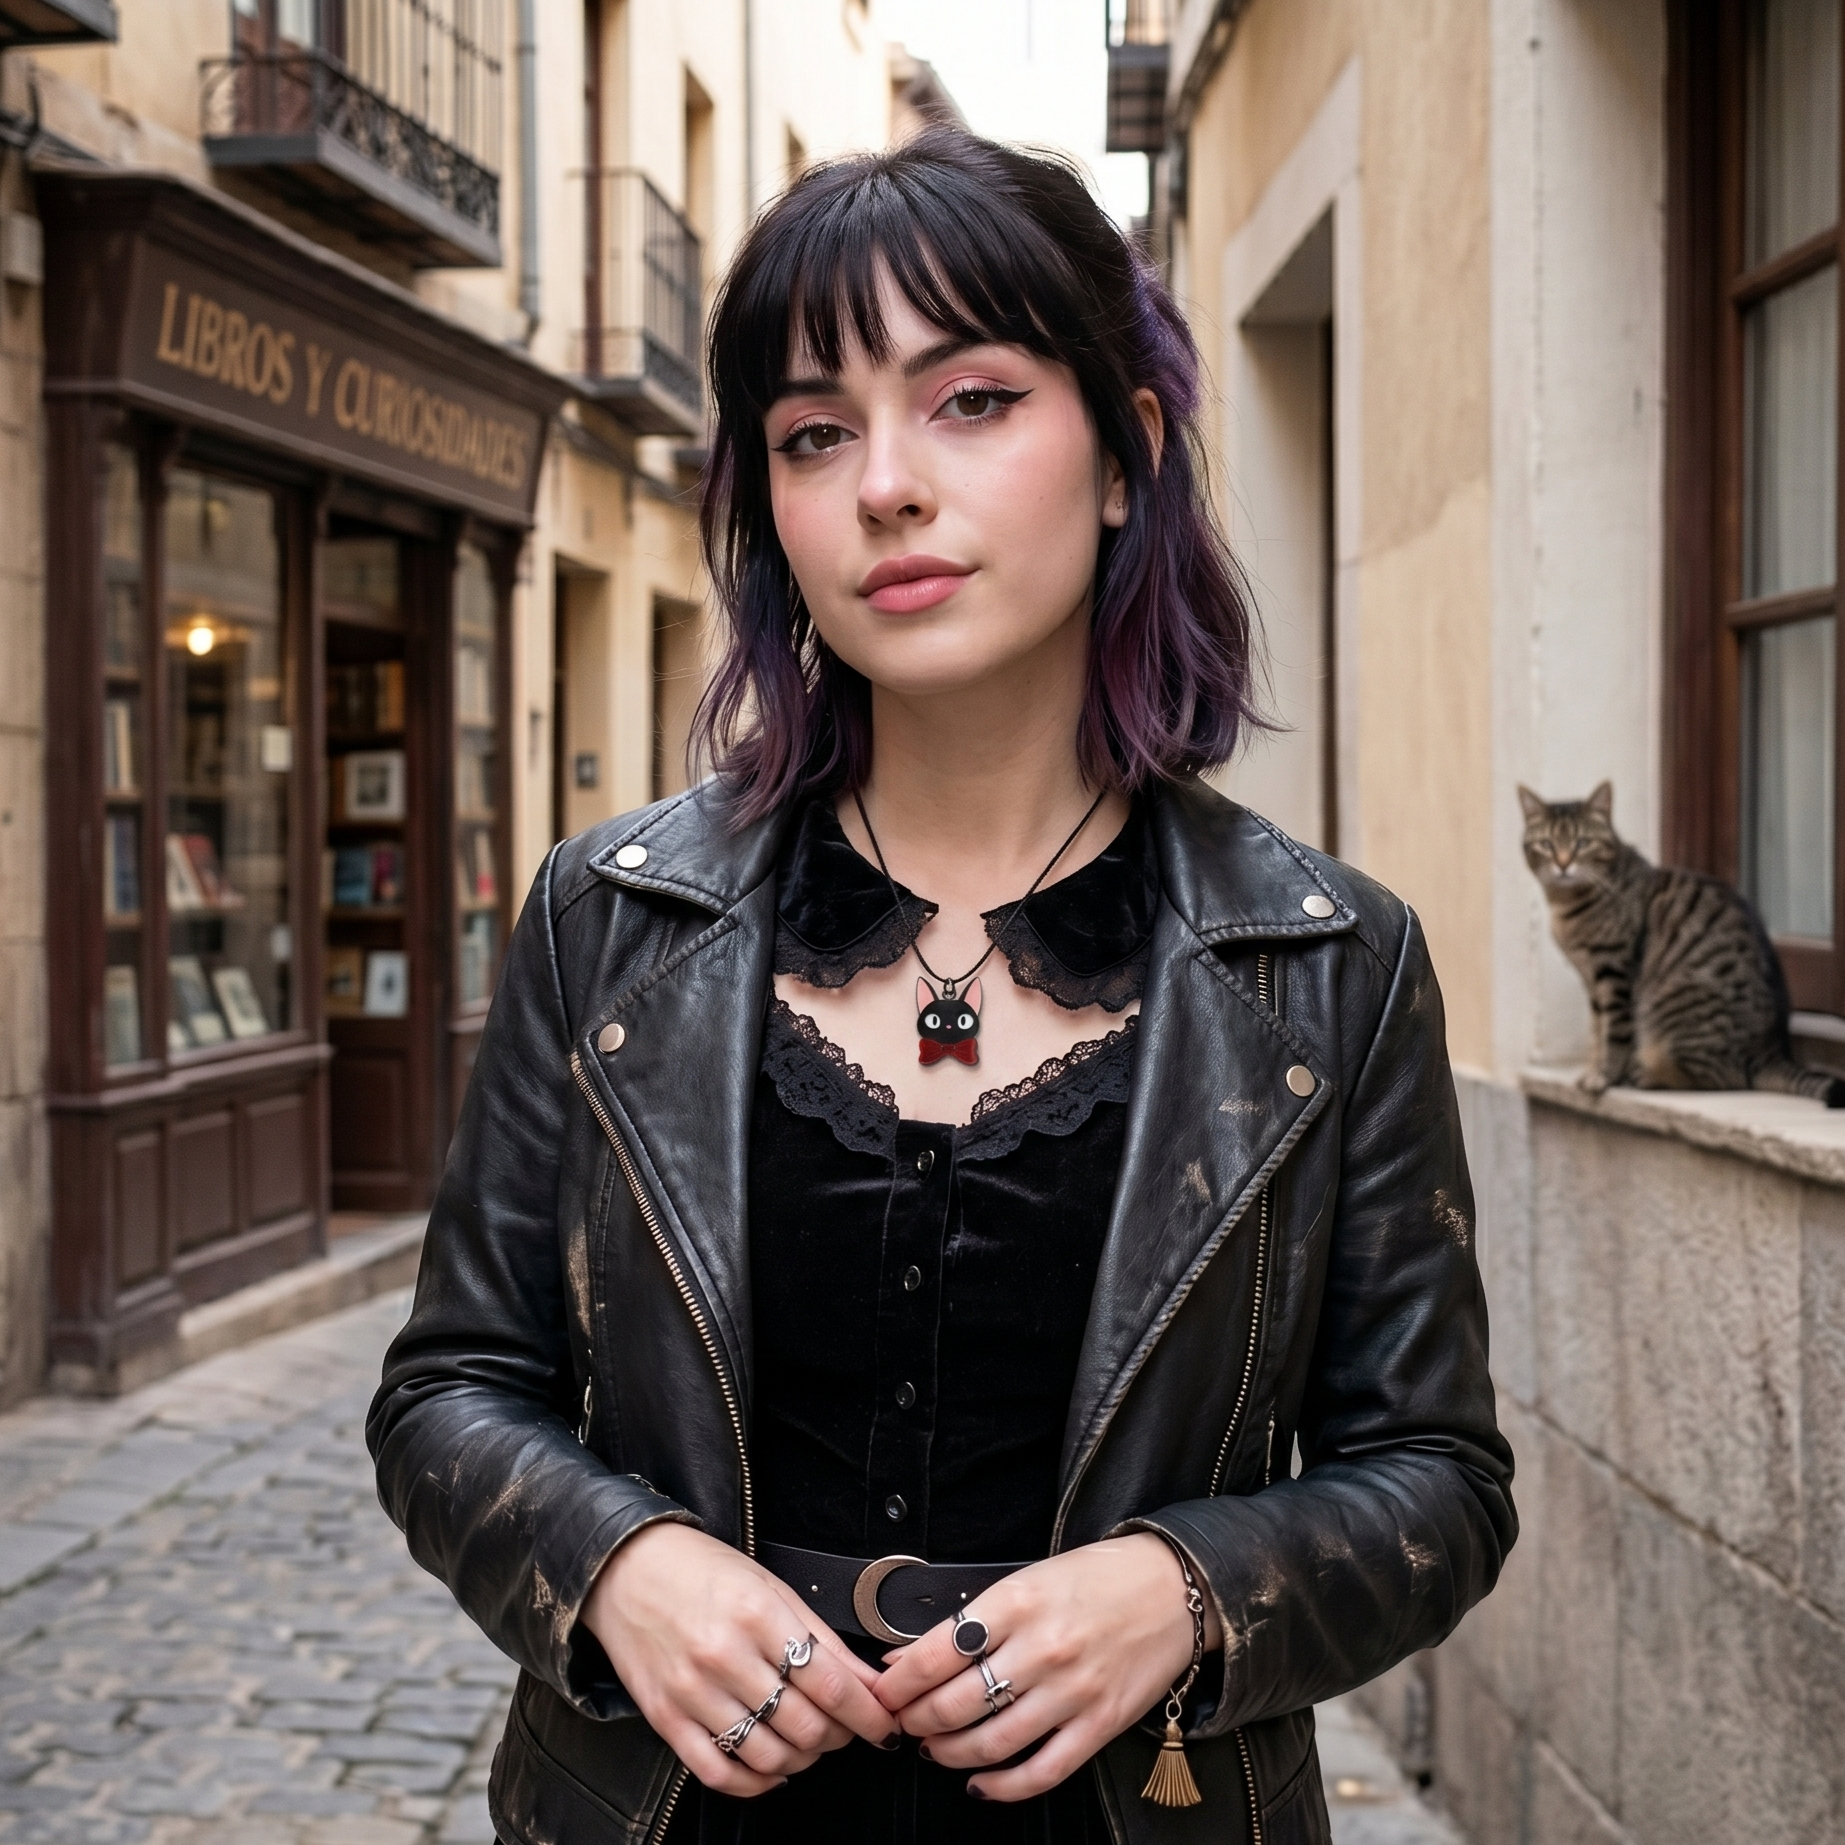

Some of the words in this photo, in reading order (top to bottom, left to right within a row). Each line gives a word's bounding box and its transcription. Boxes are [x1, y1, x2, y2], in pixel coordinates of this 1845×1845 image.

[157, 283, 295, 404] LIBROS
[305, 343, 333, 416] Y
[334, 358, 528, 489] CURIOSIDADES
